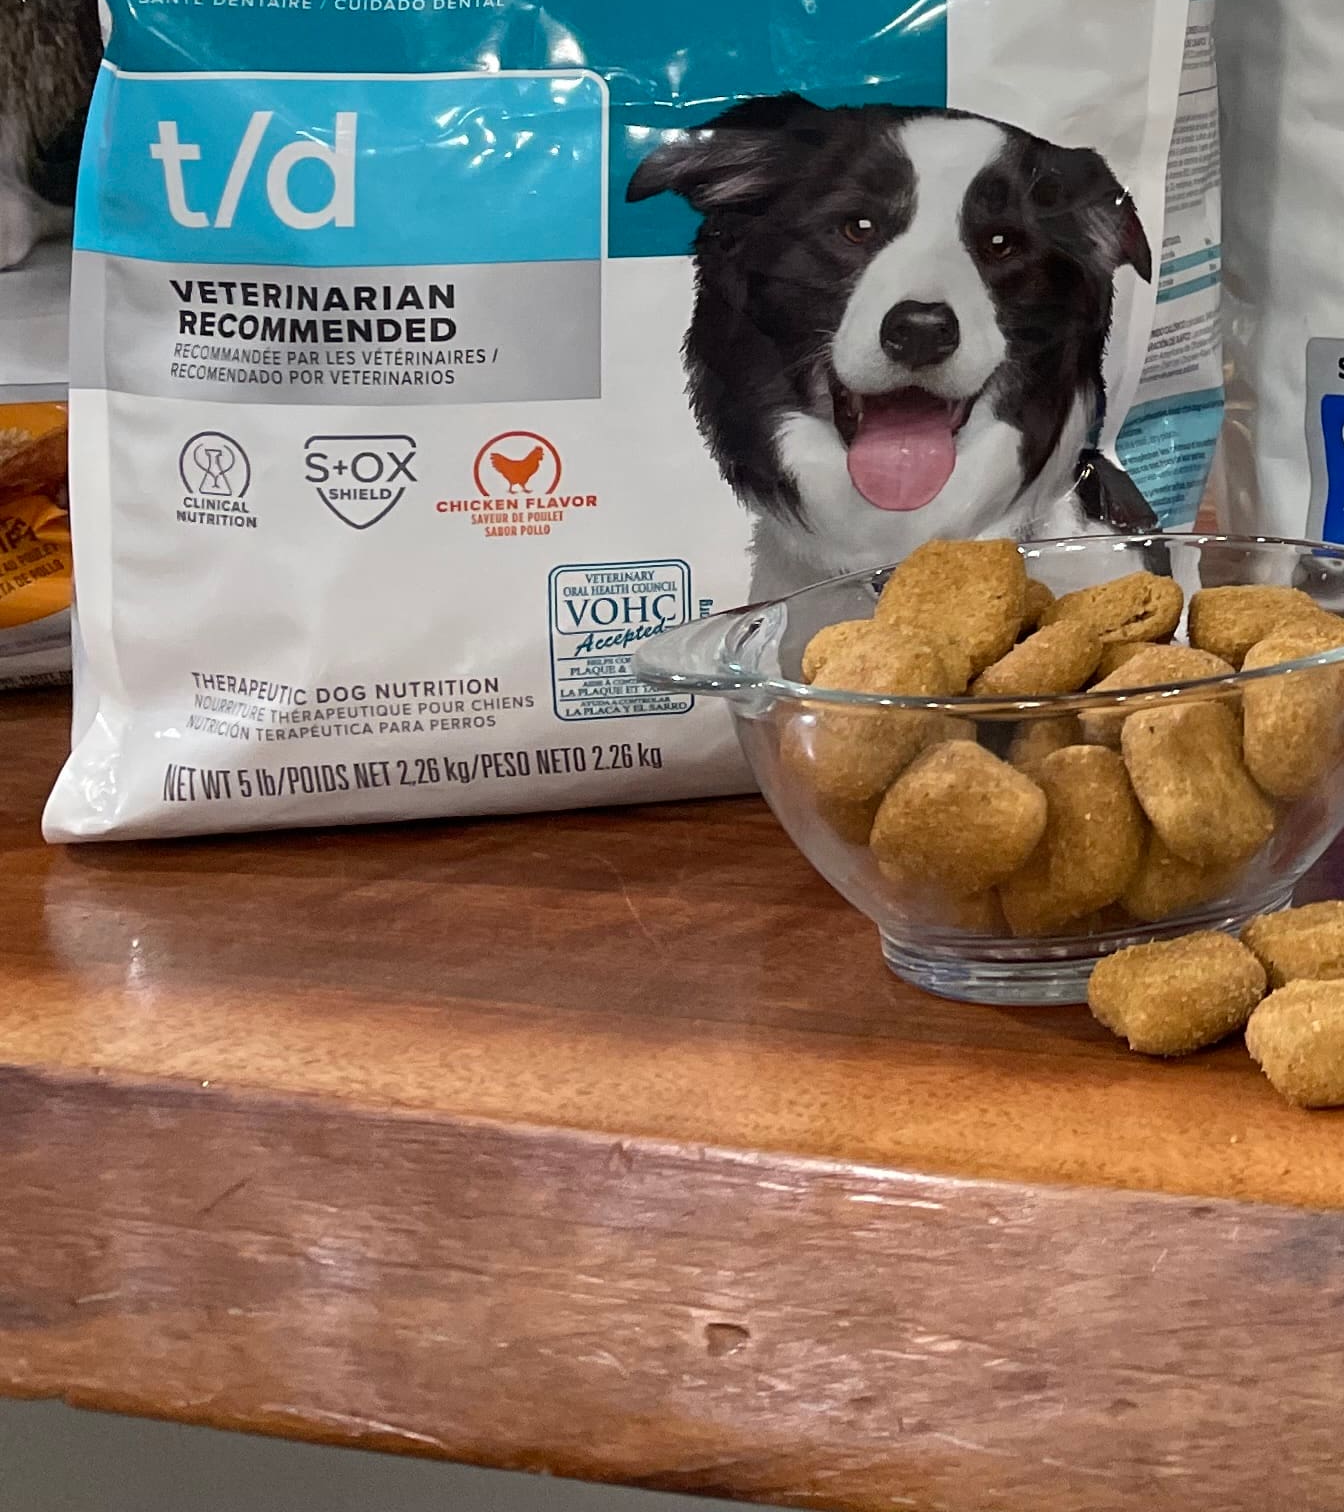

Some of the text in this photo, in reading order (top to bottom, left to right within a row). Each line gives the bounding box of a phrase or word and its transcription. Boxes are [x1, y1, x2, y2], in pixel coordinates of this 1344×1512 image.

[149, 111, 357, 230] t/d
[170, 280, 455, 311] VETERINARIAN
[179, 311, 456, 343] RECOMMENDED
[174, 343, 281, 365] RECOMMANDÉE
[287, 351, 319, 366] PAR
[326, 351, 355, 366] LES
[361, 347, 486, 366] VÉTÉRINAIRES
[170, 363, 455, 385] RECOMENDADO POR VETERINARIOS
[305, 451, 417, 483] S+OX
[183, 497, 249, 513] CLINICAL
[329, 488, 392, 500] SHIELD
[436, 496, 597, 512] CHICKEN FLAVOR
[176, 510, 257, 528] NUTRITION
[471, 511, 563, 525] SAVEUR DE POULET
[485, 525, 550, 537] SABOR POLLO
[563, 581, 677, 597] ORAL HEALTH COUNCIL
[585, 570, 655, 584] VETERINARY
[563, 594, 676, 627] VOHC
[574, 617, 666, 656] Accepted
[191, 672, 499, 706] THERAPEUTIC DOG NUTRITION
[194, 694, 535, 725] NOURRITURE THÉRAPEUTIQUE POUR CHIENS
[186, 714, 496, 742] NUTRICIÓN TERAPÉUTICA PARA PERROS
[163, 763, 196, 801] NET
[200, 768, 231, 800] WT
[238, 769, 252, 798] 5
[353, 761, 391, 789] NET
[396, 757, 441, 786] 2,26
[536, 746, 587, 776] NETO
[592, 743, 633, 771] 2.26
[637, 742, 663, 769] kg
